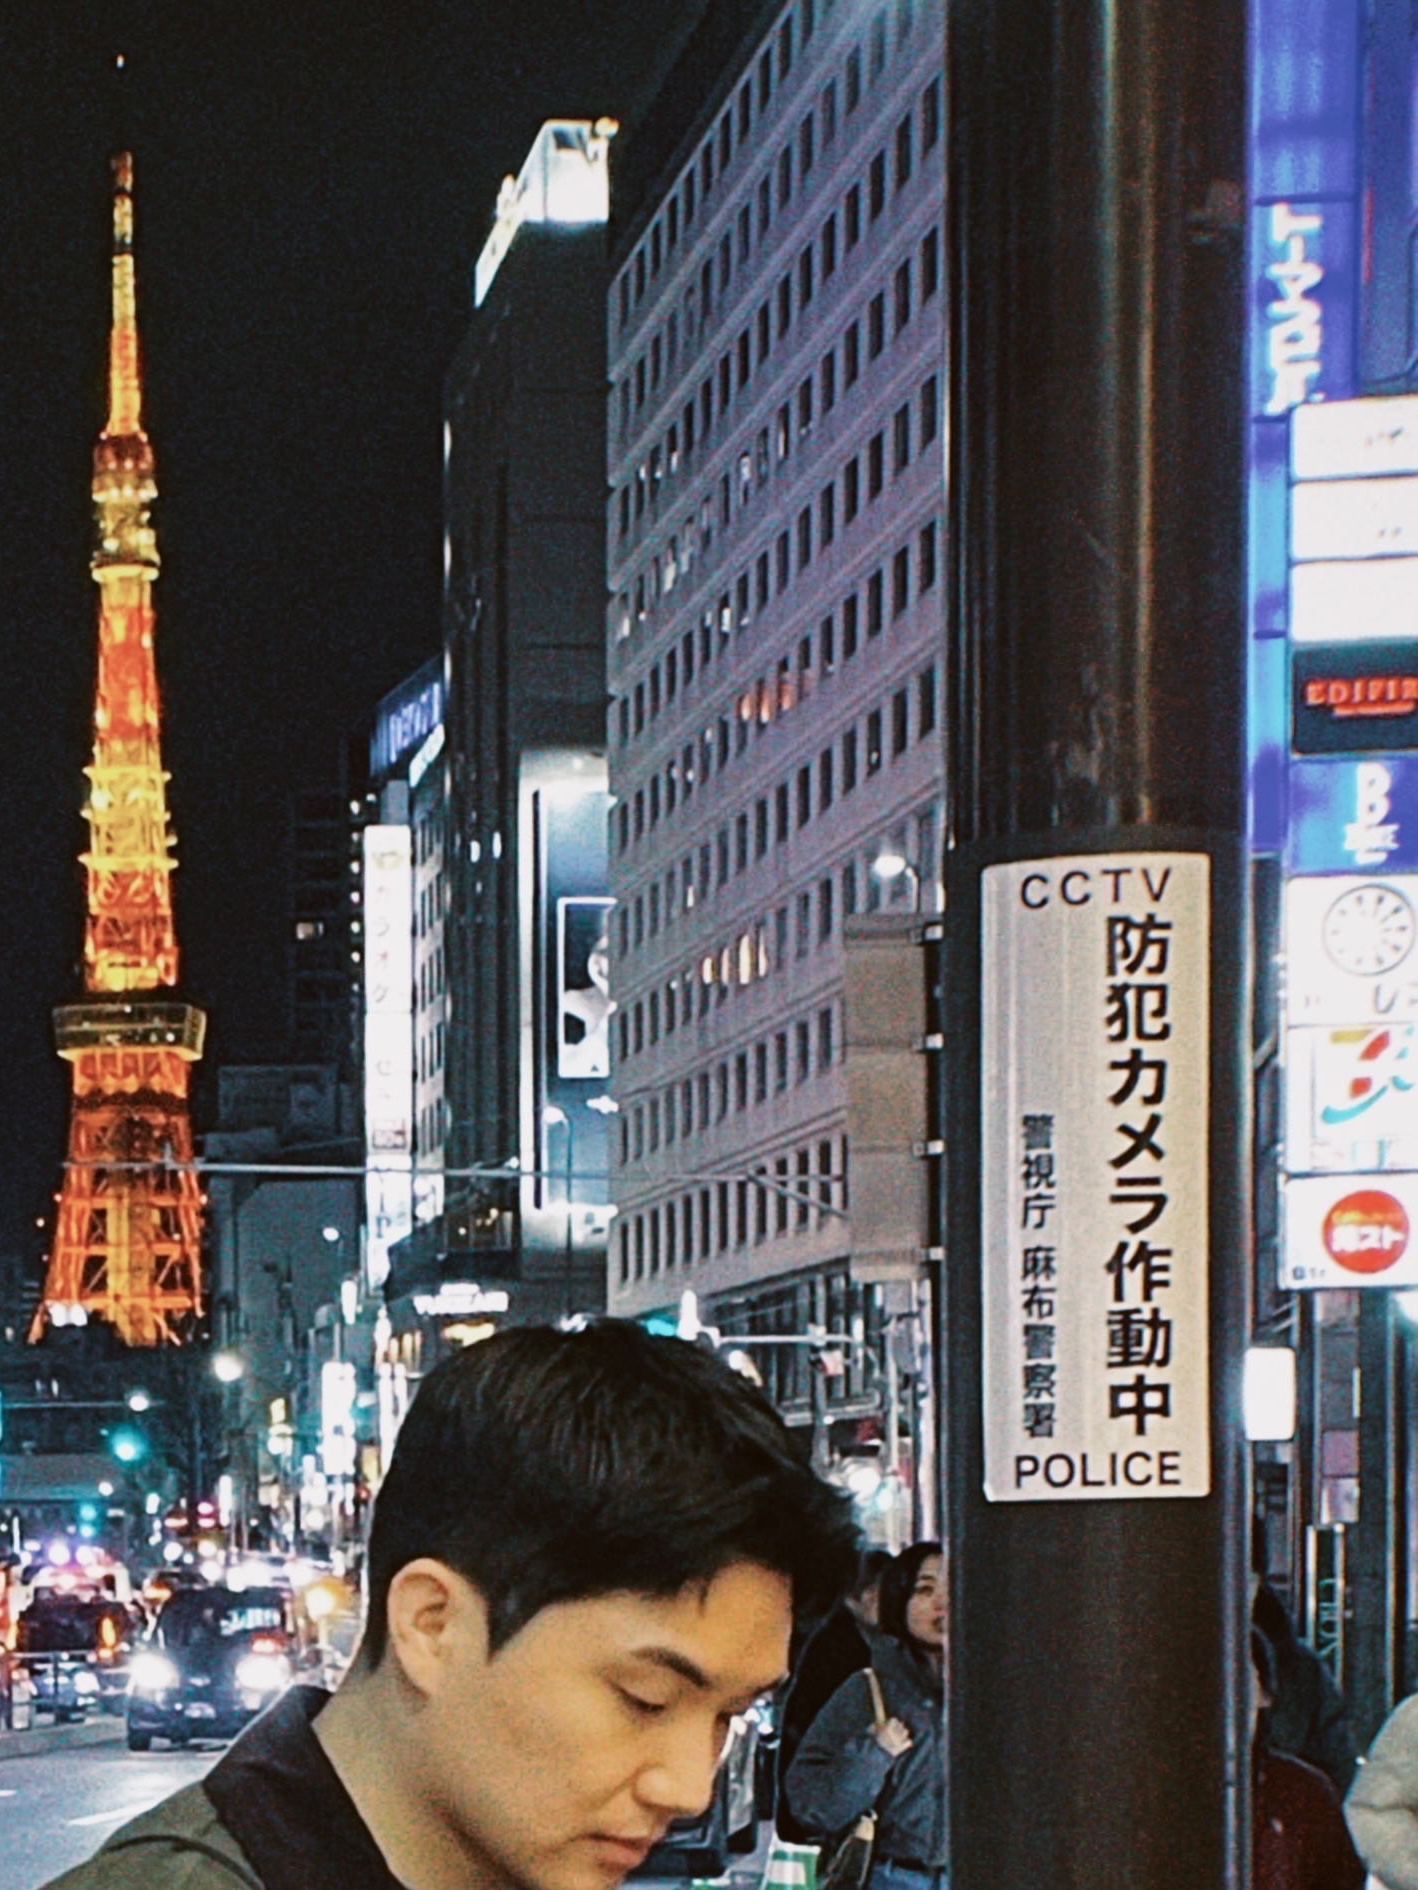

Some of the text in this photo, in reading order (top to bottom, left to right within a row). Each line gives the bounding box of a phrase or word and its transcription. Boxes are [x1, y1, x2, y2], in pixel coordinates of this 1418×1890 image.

[1020, 866, 1172, 909] CCTV
[1104, 912, 1173, 1438] 防犯カメラ作動中
[1021, 1113, 1057, 1439] 警視庁 麻布警察署
[1015, 1451, 1182, 1488] POLICE
